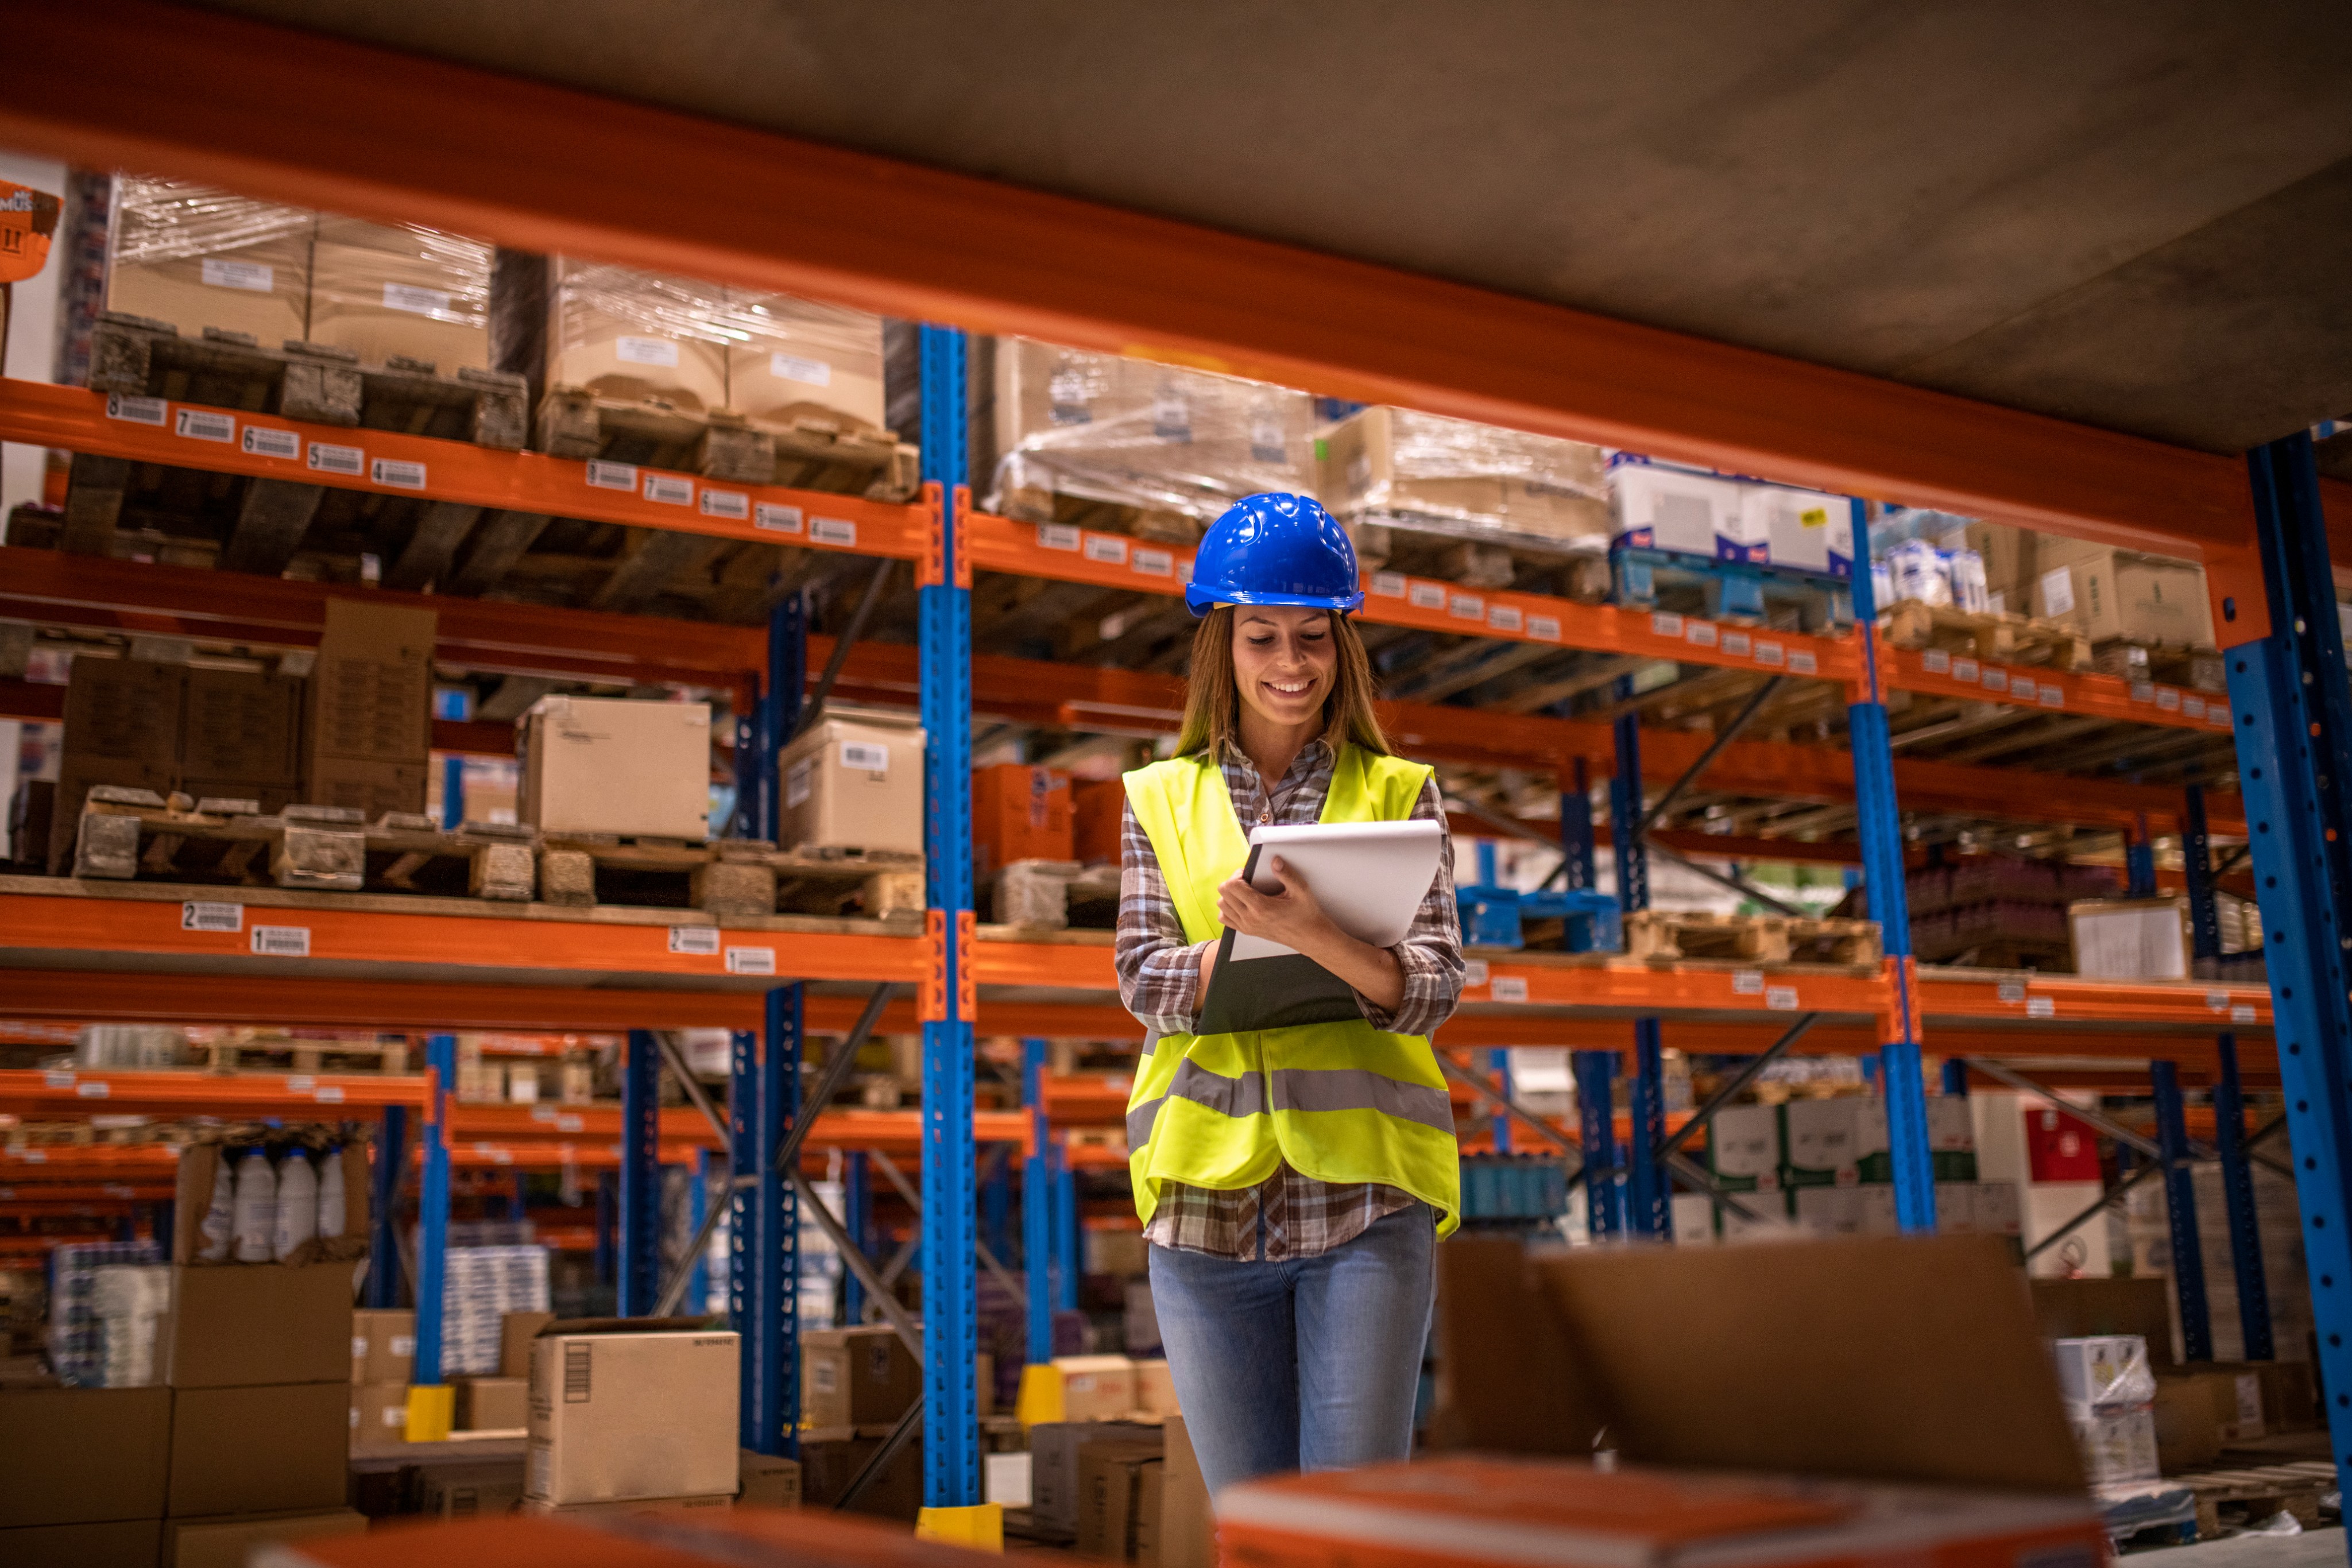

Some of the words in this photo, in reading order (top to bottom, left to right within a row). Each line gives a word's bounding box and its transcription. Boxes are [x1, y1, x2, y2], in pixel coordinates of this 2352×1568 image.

[179, 411, 188, 433] 7
[244, 428, 254, 451] 6
[309, 445, 319, 467] 5
[373, 462, 382, 480] 4
[184, 904, 195, 927] 2
[256, 930, 262, 950] 1
